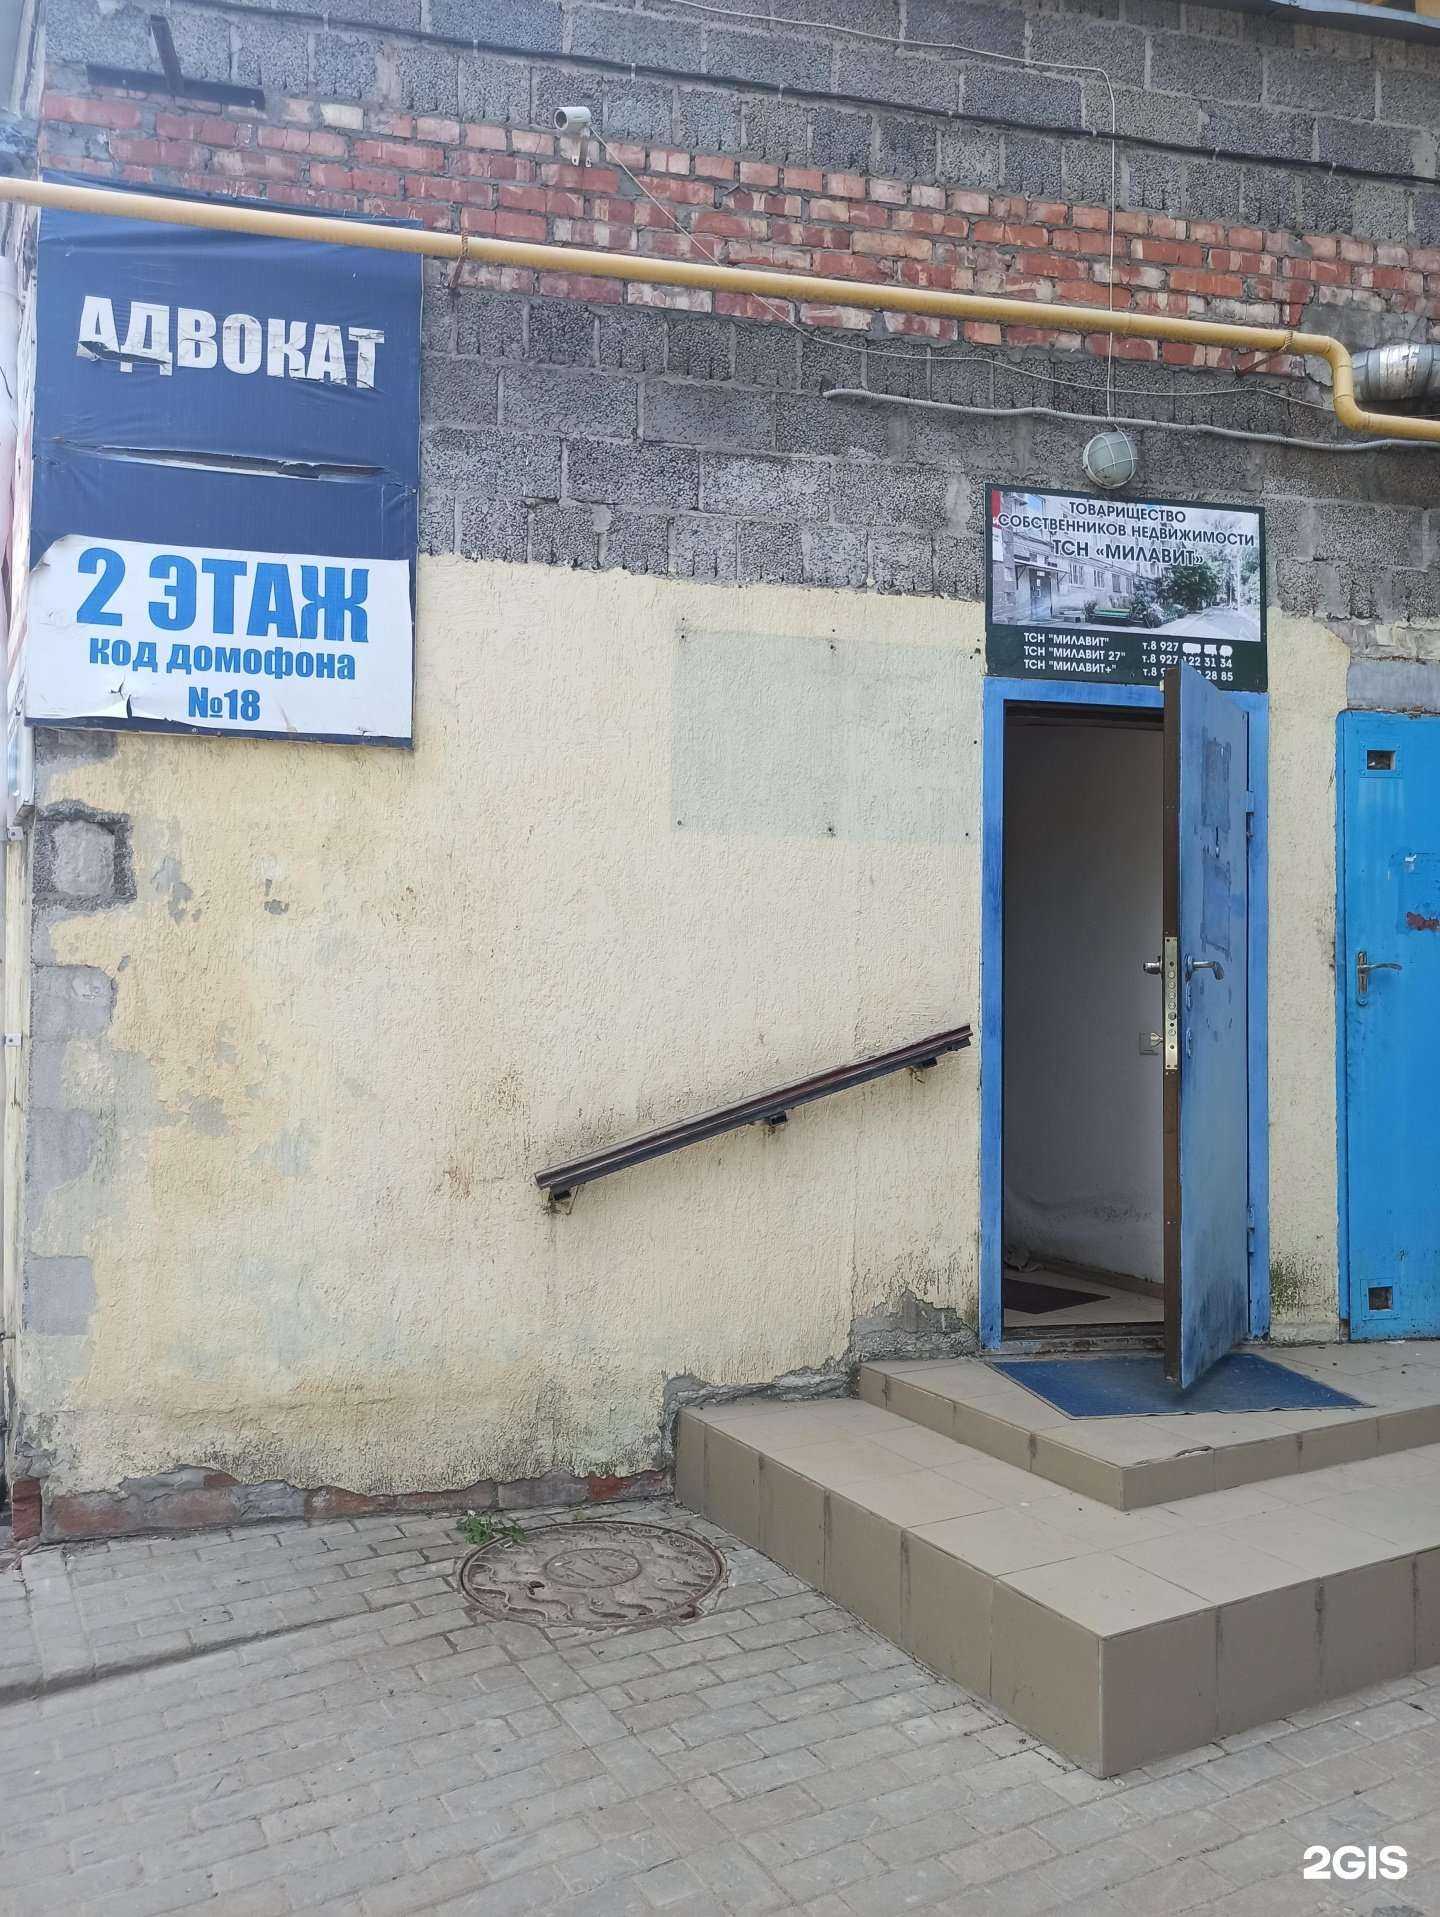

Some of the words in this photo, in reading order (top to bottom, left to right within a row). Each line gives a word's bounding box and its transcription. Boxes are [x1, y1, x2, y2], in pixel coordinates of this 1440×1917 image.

[76, 295, 385, 389] АДВОКАТ
[1069, 501, 1186, 523] ТОВАРИЩЕСТВО
[998, 513, 1127, 537] СОБСТВЕННИКОВ
[1131, 525, 1255, 547] НЕДВИЖИМОСТИ
[1051, 539, 1090, 558] ТСН
[1096, 544, 1204, 567] «МИЛАВИТ»
[76, 547, 126, 627] 2
[148, 554, 370, 643] ЭТАЖ
[1023, 632, 1046, 643] ТСН
[1048, 633, 1110, 647] "МИЛАВИТ"
[1160, 641, 1179, 652] 927
[166, 643, 356, 681] домофона
[1023, 645, 1046, 657] ТСН
[1160, 654, 1179, 665] 927
[1204, 657, 1217, 667] 31
[1220, 658, 1232, 668] 34
[1023, 659, 1046, 670] ТСН
[1205, 670, 1218, 681] 28
[1220, 671, 1234, 682] 85
[187, 686, 261, 723] №18
